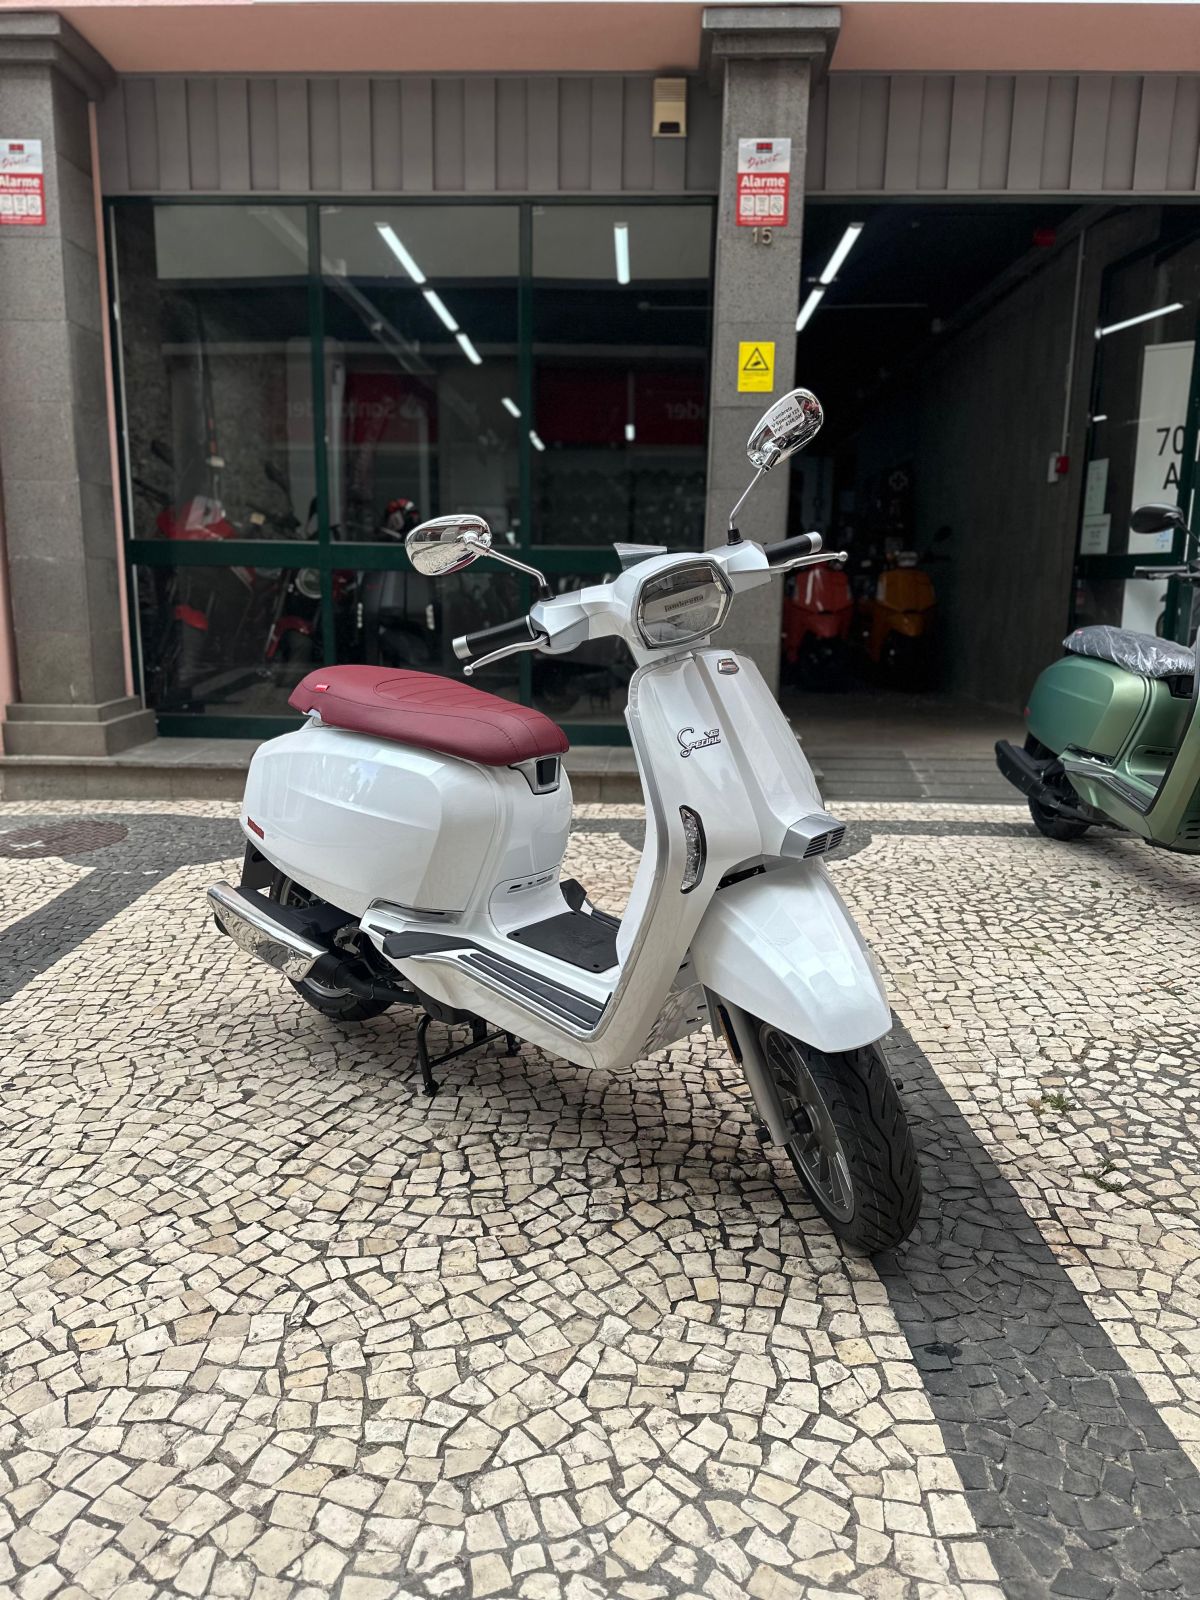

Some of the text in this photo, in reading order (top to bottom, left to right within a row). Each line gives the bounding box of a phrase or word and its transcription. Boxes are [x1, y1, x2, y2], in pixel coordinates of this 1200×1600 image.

[741, 174, 786, 187] Alarme
[752, 227, 772, 245] 15
[1162, 462, 1179, 490] A
